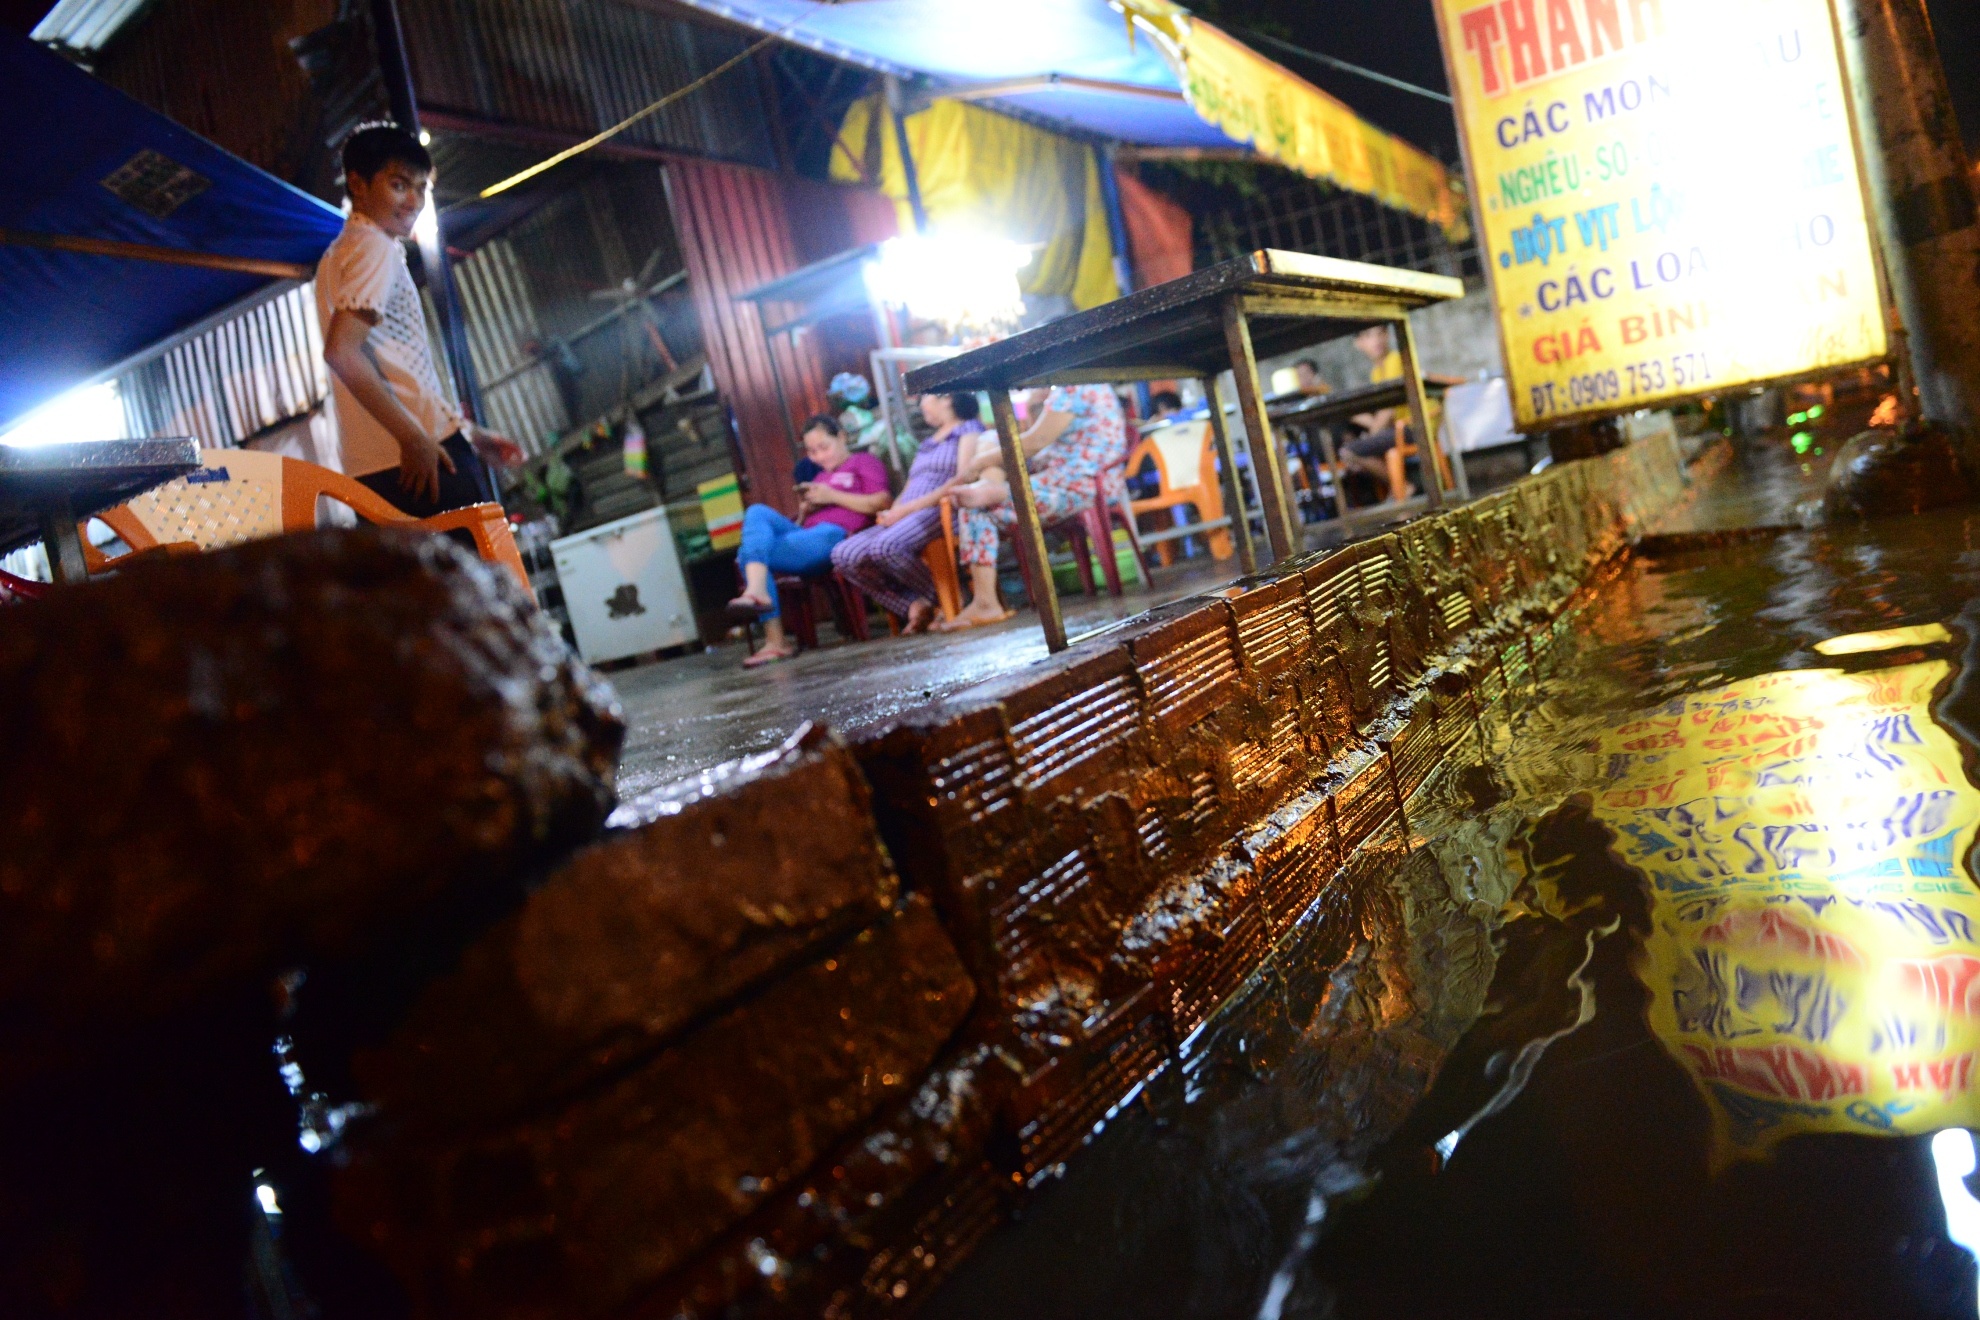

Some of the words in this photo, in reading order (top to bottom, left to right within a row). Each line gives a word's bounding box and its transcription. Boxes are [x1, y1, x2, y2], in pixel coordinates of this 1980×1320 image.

[1496, 98, 1569, 148] CÁC
[1537, 264, 1615, 312] CÁC
[1533, 317, 1602, 364] GIÁ
[1626, 360, 1665, 395] 753
[1672, 352, 1712, 385] 571
